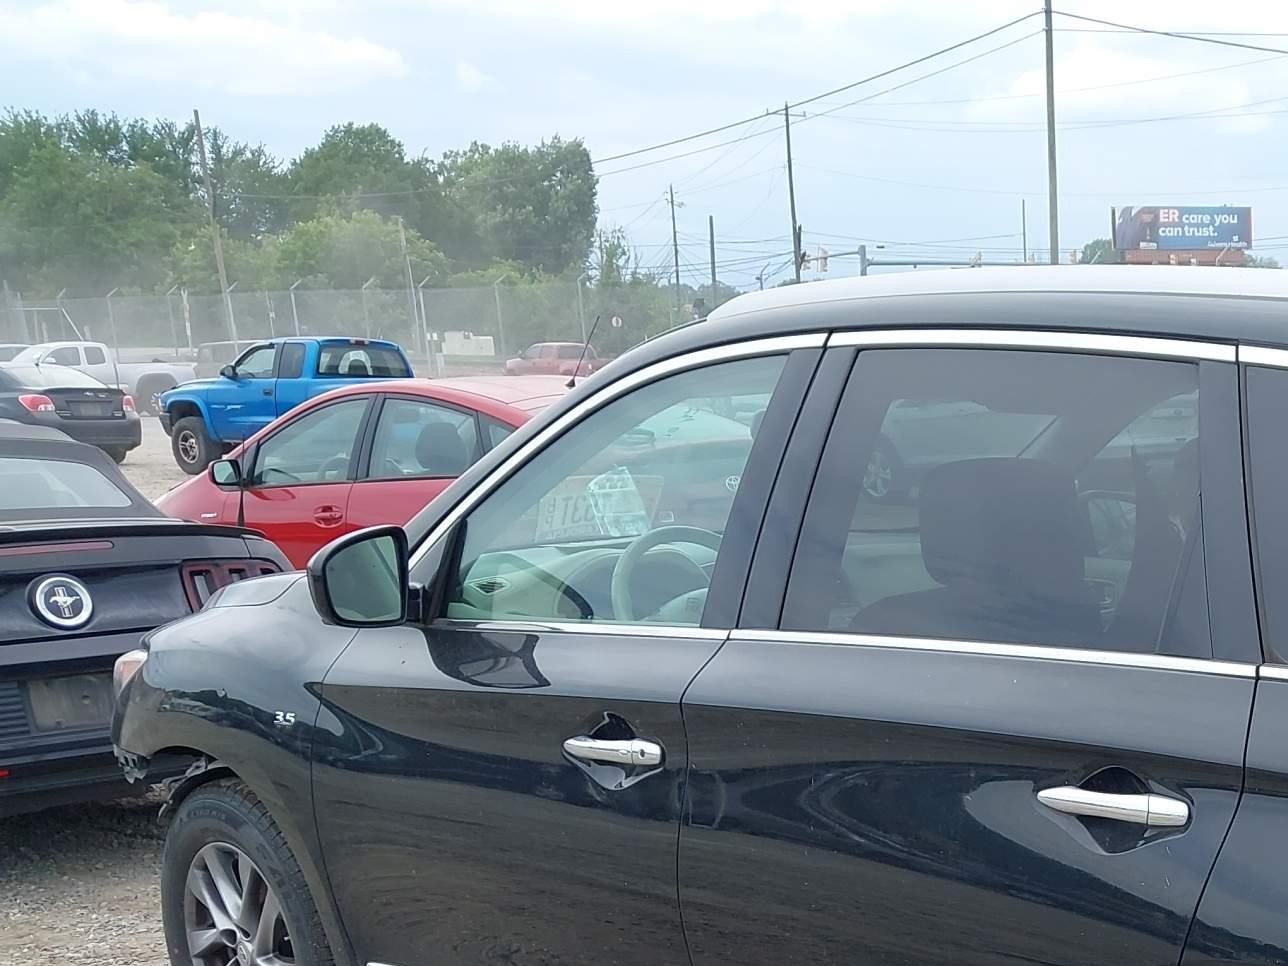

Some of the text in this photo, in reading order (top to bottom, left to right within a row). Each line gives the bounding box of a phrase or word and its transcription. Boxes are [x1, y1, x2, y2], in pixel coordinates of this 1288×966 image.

[1159, 209, 1238, 227] ER care you
[1158, 225, 1218, 237] can trust.
